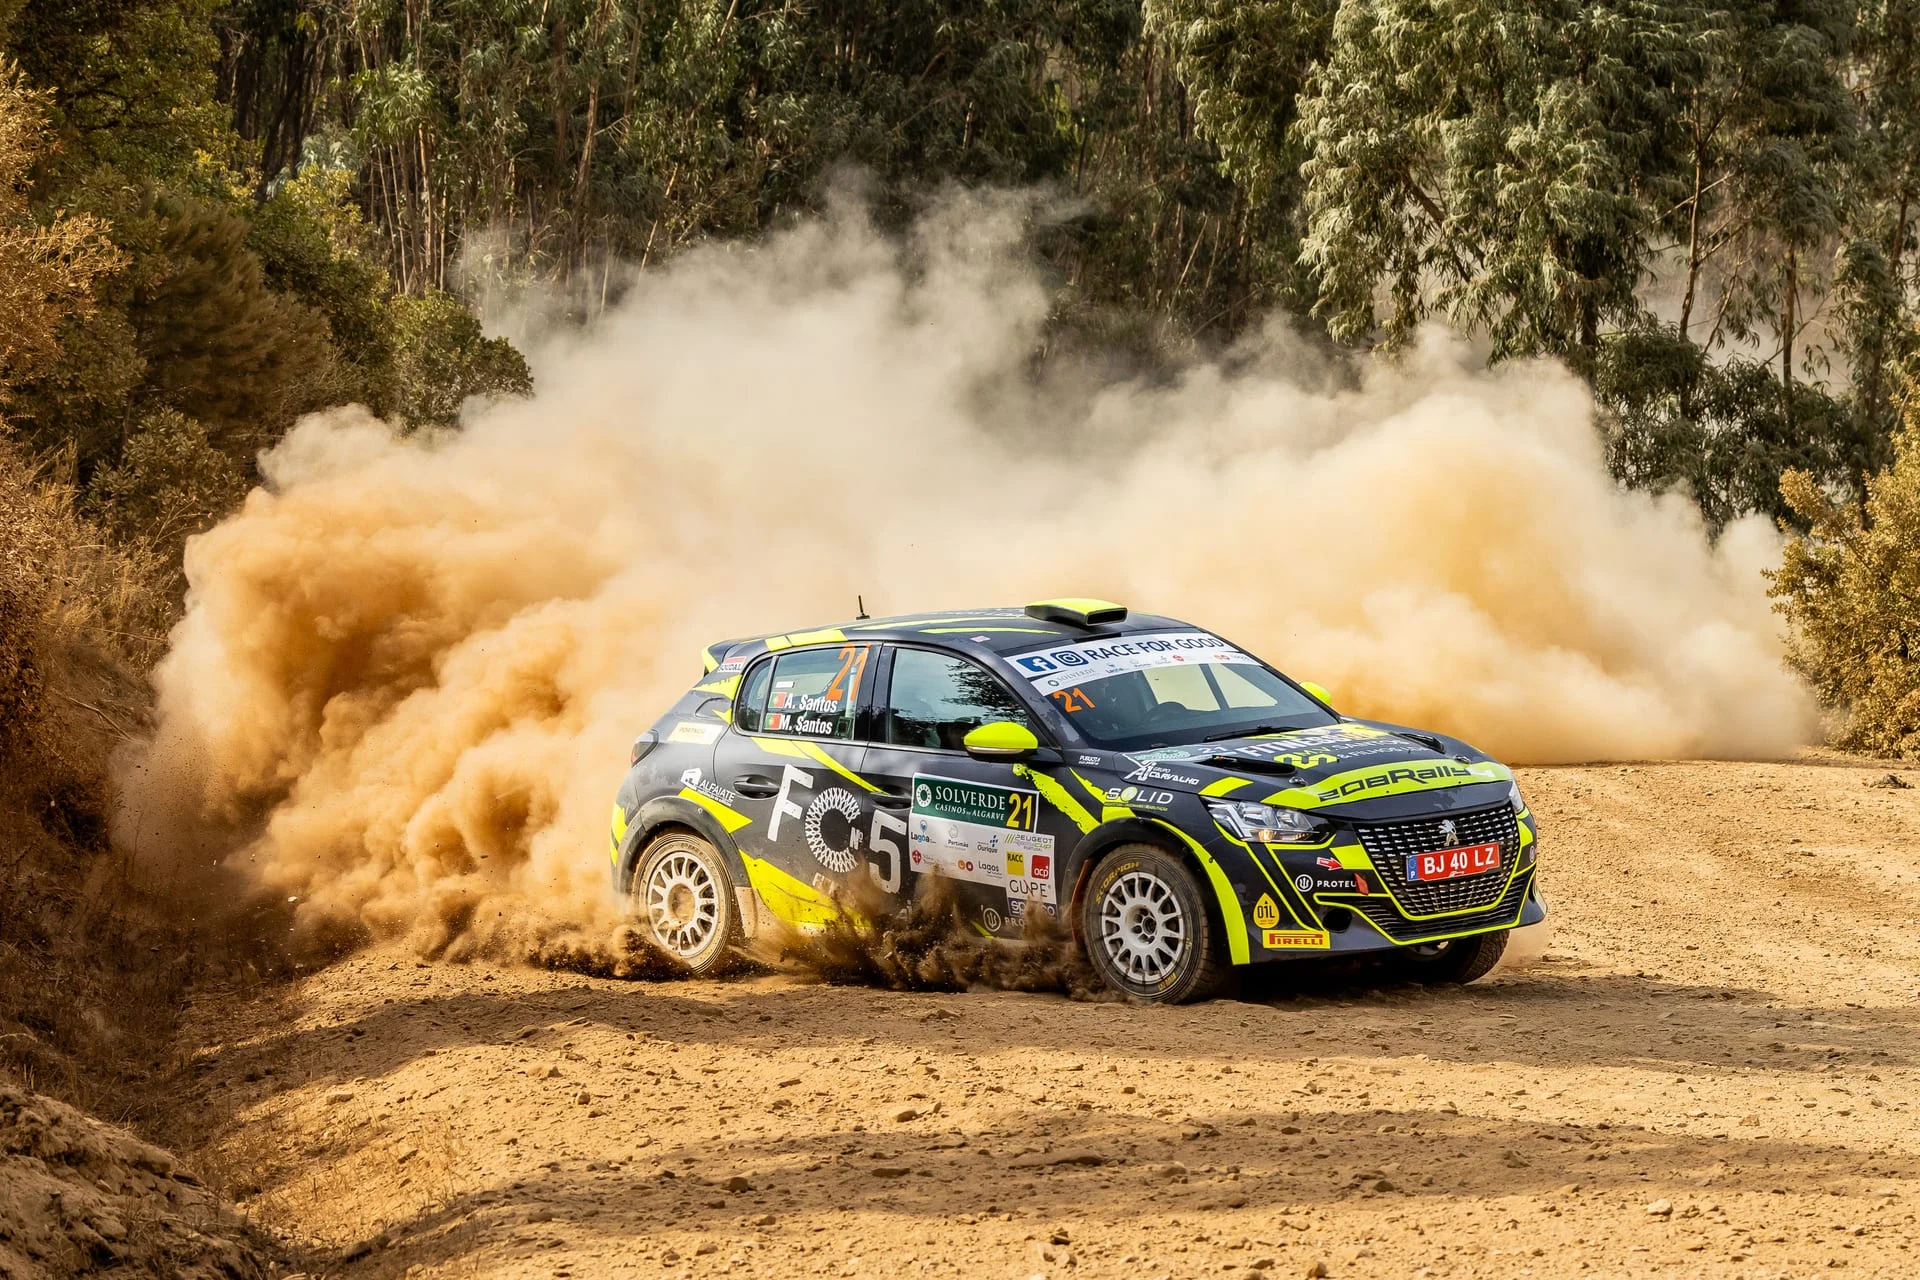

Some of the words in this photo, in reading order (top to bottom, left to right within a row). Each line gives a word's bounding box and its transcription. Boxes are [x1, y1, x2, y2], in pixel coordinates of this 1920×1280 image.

[1084, 643, 1140, 660] RACE
[1136, 639, 1174, 654] FOR
[1174, 637, 1226, 649] GOOD
[826, 642, 871, 701] 21
[784, 693, 796, 710] A.
[799, 693, 839, 714] Santos
[1053, 687, 1096, 713] 21
[779, 714, 793, 731] M.
[795, 716, 833, 735] Santos
[1148, 771, 1200, 786] CARVALHO
[1152, 766, 1171, 775] GRUPO
[699, 779, 736, 803] ALFAIATE
[935, 785, 1006, 811] SOLVERDE
[1005, 793, 1033, 831] 21
[935, 802, 966, 815] CASINOS
[972, 809, 1005, 821] ALGARVE
[910, 831, 930, 844] Lagoa
[1015, 833, 1053, 844] PEUGEOT
[977, 844, 998, 854] Ourique
[1006, 852, 1024, 863] RACC
[978, 860, 1000, 874] Lagos
[1423, 856, 1446, 875] BJ
[1449, 851, 1468, 870] 40
[1473, 847, 1495, 867] LZ
[1095, 861, 1139, 905] SCORPION
[1410, 870, 1416, 879] P
[1316, 880, 1357, 888] PROTEU
[1269, 933, 1324, 945] PIRELLI
